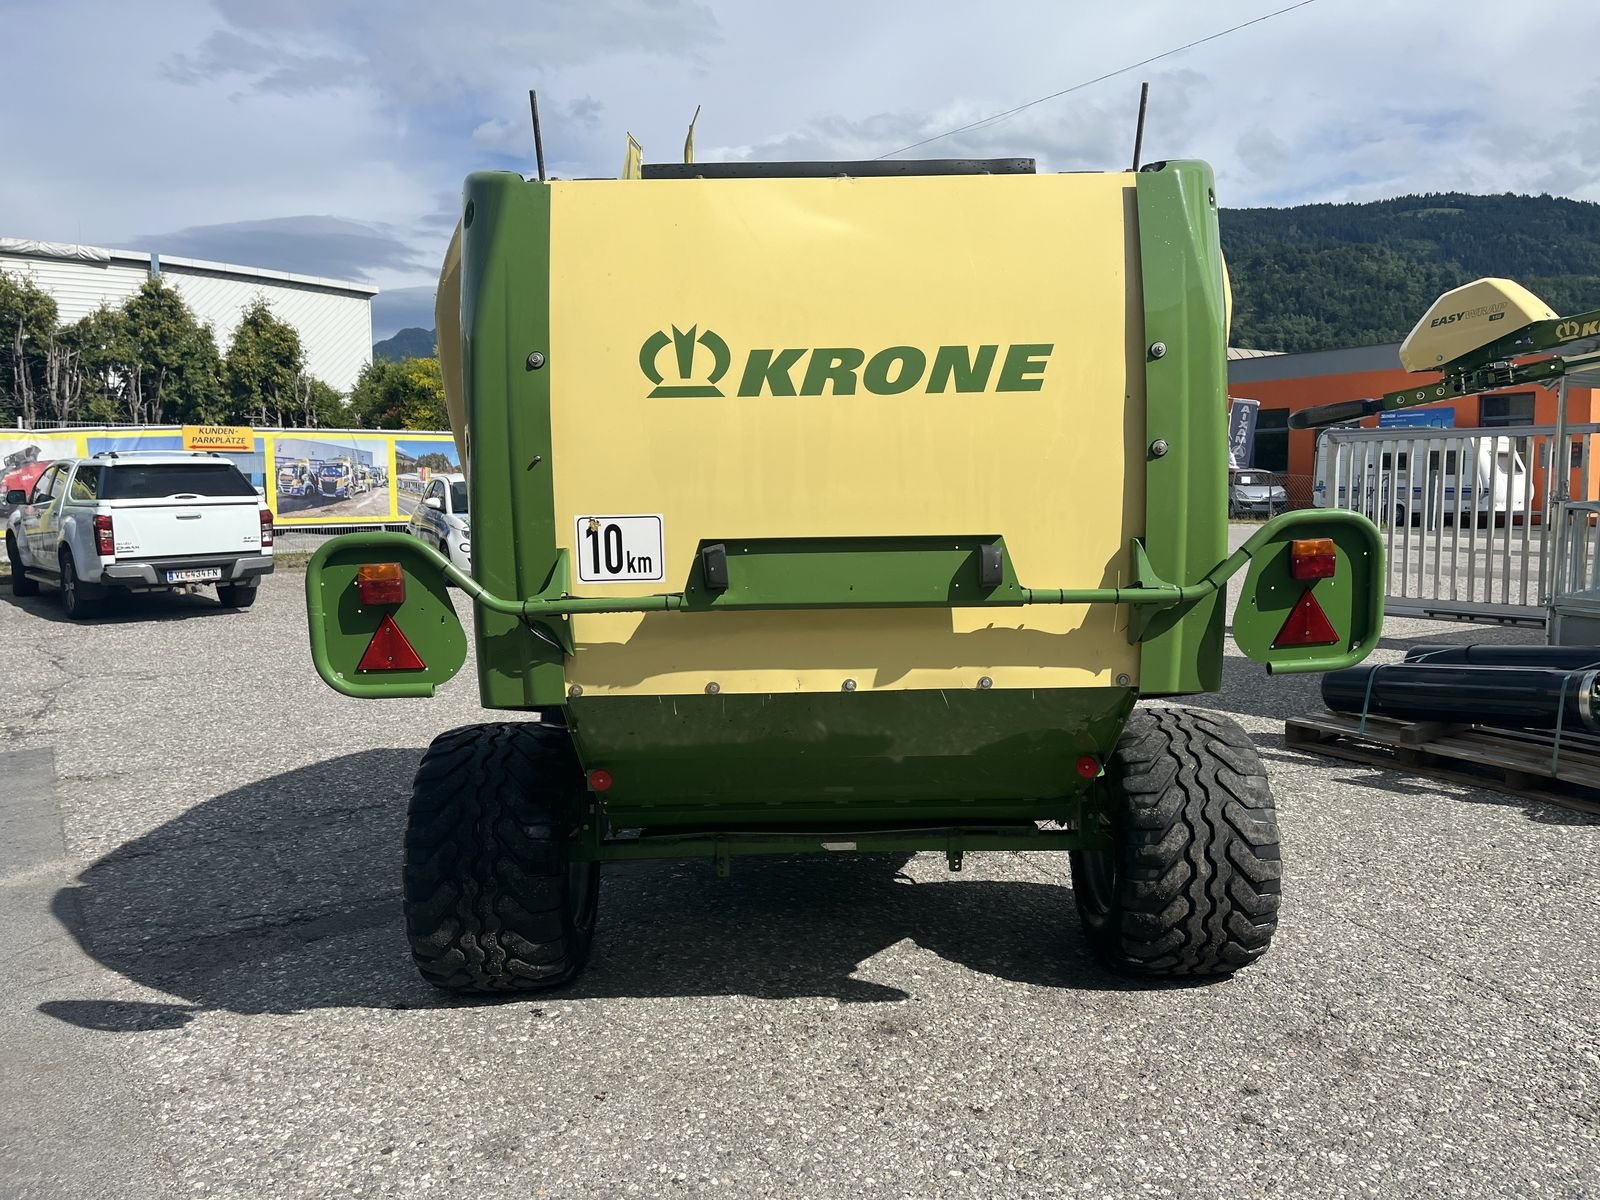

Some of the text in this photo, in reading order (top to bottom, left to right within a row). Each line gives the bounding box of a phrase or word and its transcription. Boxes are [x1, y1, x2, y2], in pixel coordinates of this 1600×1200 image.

[1581, 319, 1600, 337] K
[736, 343, 1054, 397] KRONE
[198, 427, 238, 435] KUNDEN-
[1234, 405, 1251, 444] AIXAM
[191, 434, 246, 444] PARKPLÄTZE
[586, 523, 652, 574] 10 km
